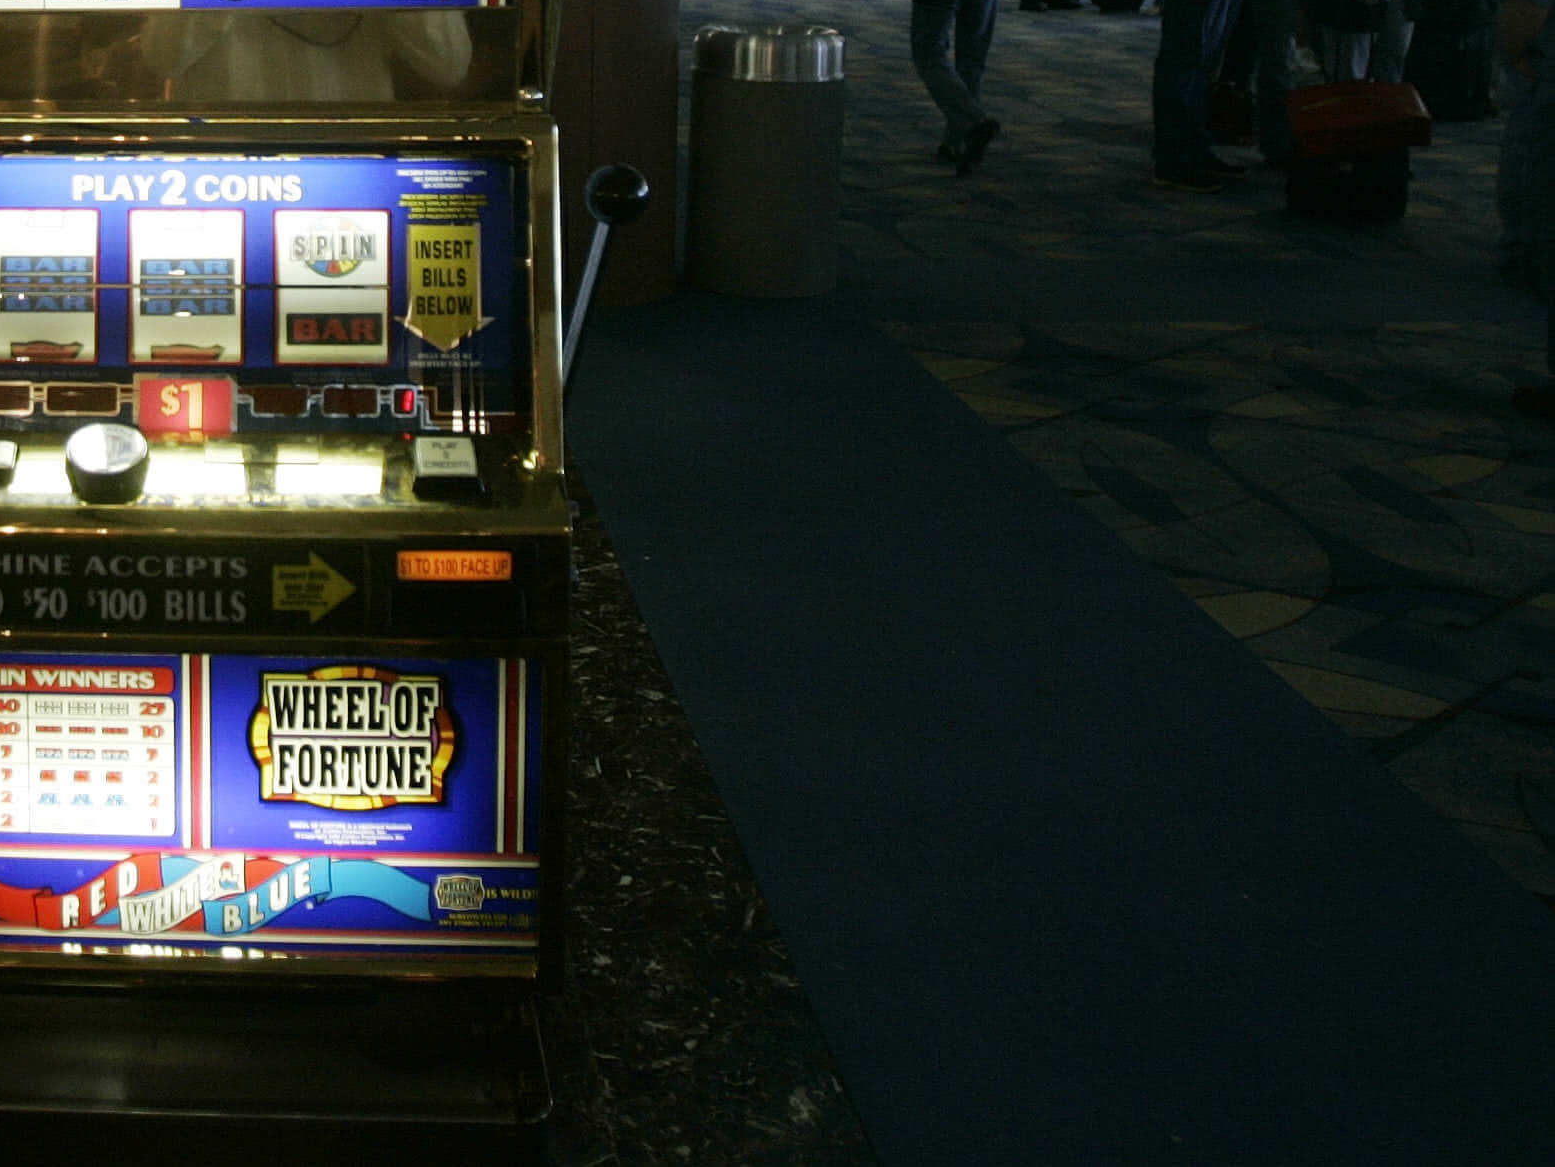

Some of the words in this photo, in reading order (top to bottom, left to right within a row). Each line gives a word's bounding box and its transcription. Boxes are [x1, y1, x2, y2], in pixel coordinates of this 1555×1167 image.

[72, 175, 155, 201] PLAY
[160, 170, 188, 205] 2
[194, 174, 303, 202] COINS
[295, 236, 373, 259] SPIN
[415, 241, 473, 259] INSERT
[423, 268, 467, 287] BILLS
[417, 296, 472, 315] BELOW
[293, 319, 375, 341] BAR
[161, 383, 204, 432] $1
[85, 554, 247, 578] ACCEPTS
[416, 559, 432, 575] TO
[461, 559, 489, 575] FACE
[493, 560, 509, 575] UP
[24, 588, 68, 619] $50
[87, 589, 147, 620] $100
[165, 590, 245, 621] BILLS
[32, 670, 155, 689] WINNERS
[272, 684, 387, 729] WHEEL
[393, 684, 438, 731] OF
[278, 742, 431, 790] FORTUNE
[62, 862, 137, 927] RED
[131, 865, 217, 932] WHITE
[224, 867, 310, 932] BLUE
